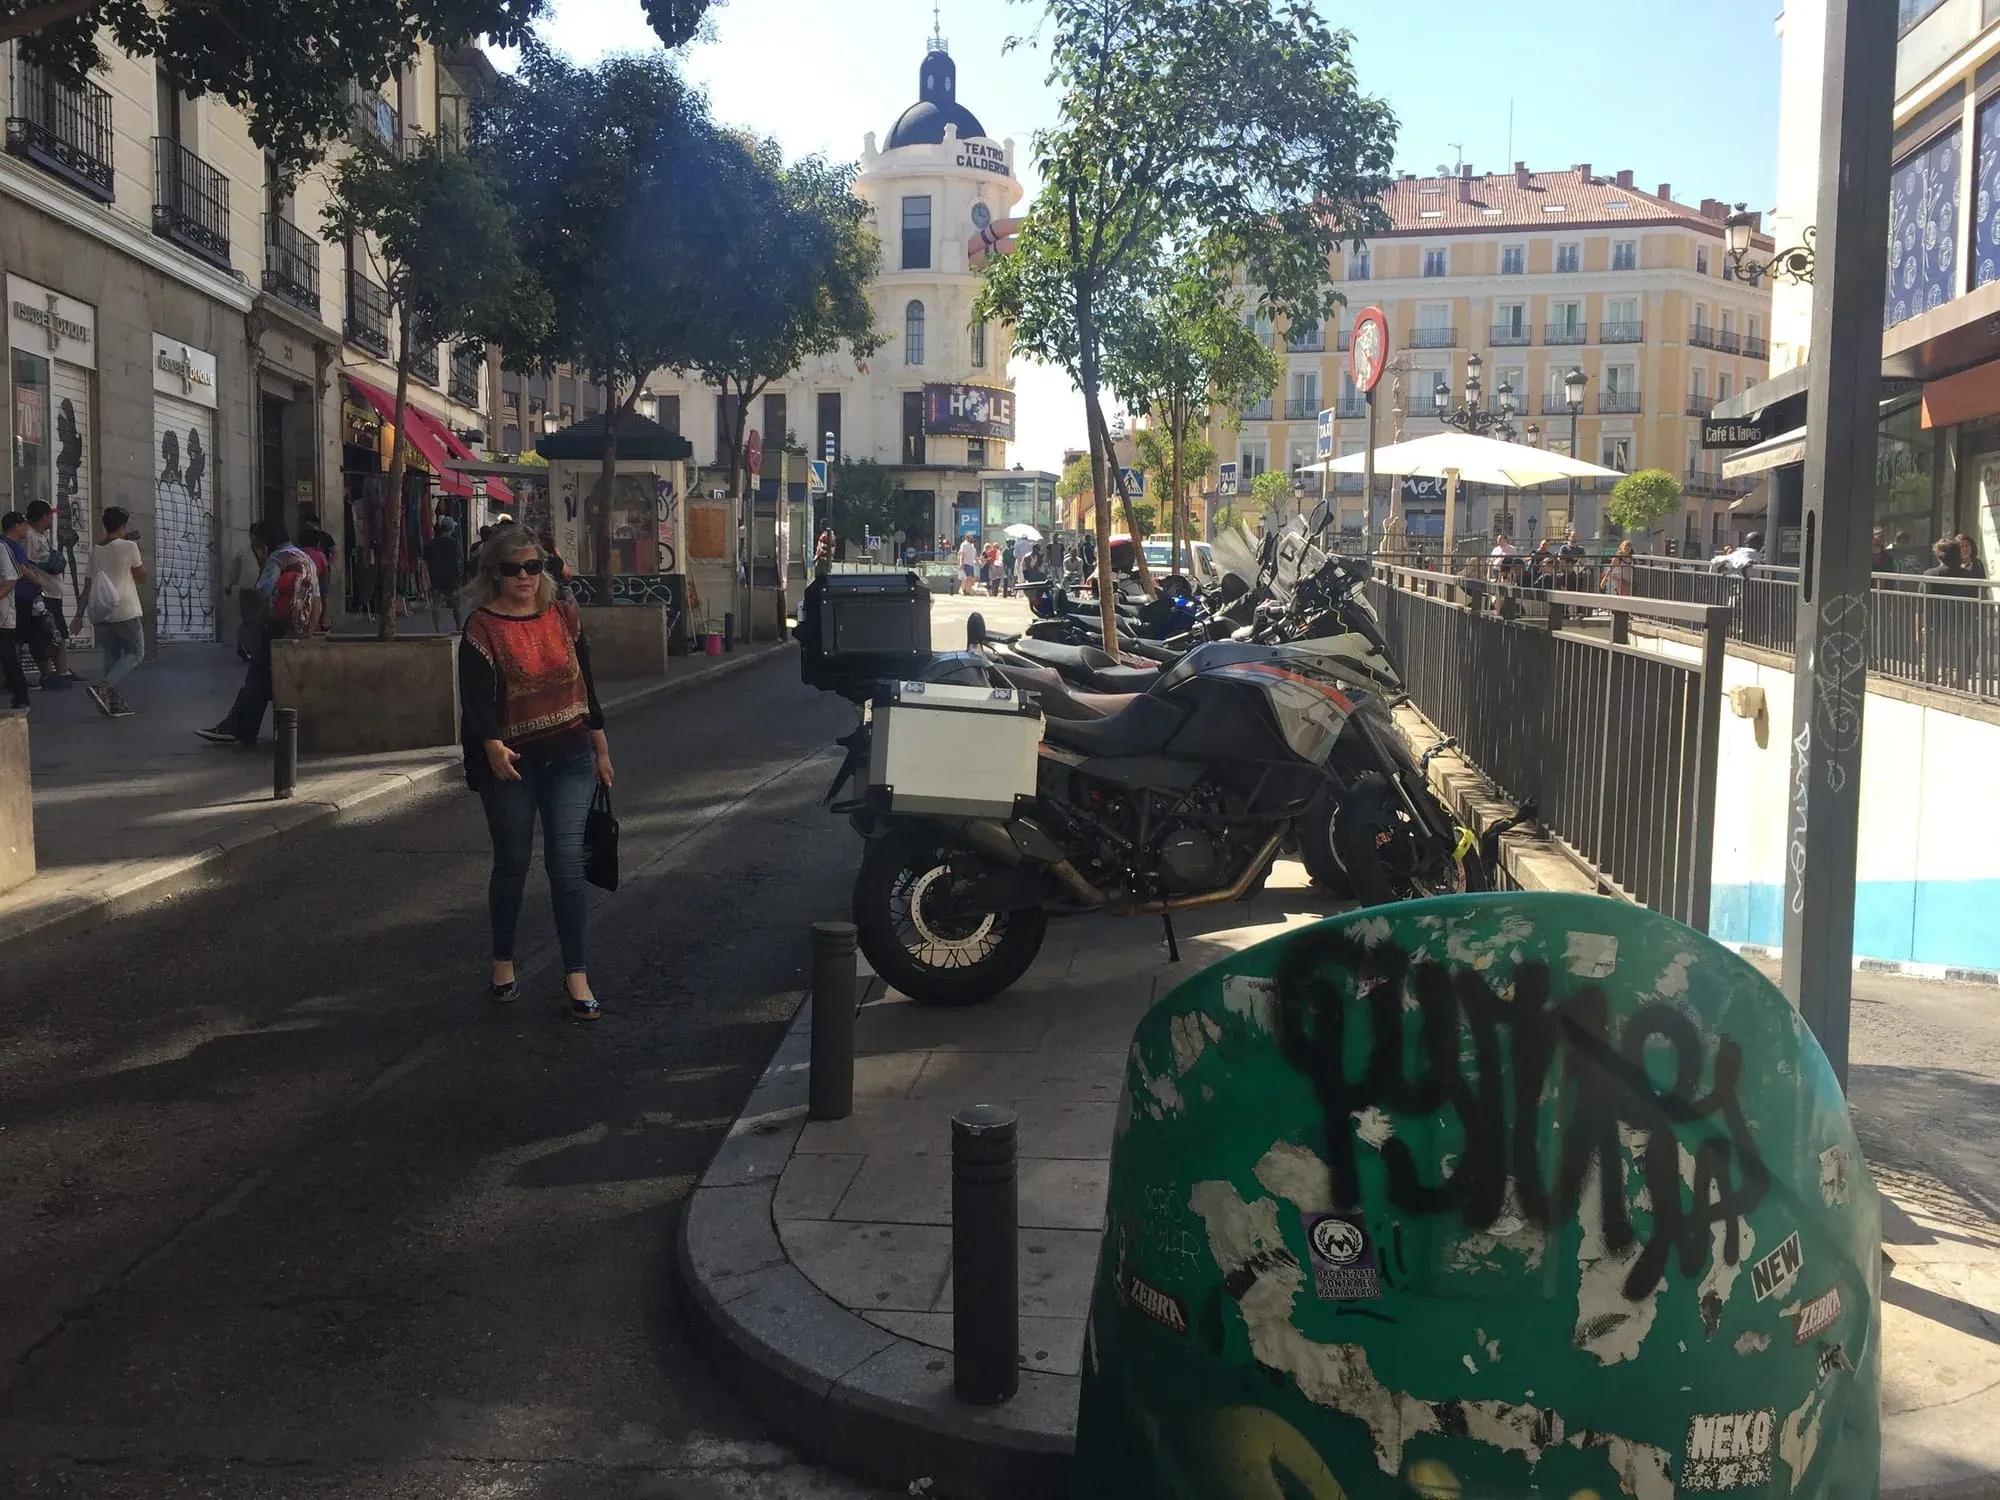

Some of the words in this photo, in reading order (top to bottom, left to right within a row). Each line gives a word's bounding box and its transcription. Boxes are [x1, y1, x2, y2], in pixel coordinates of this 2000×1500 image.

[963, 142, 1003, 161] TEATRO
[956, 155, 1009, 176] CALDERON
[57, 318, 91, 343] DUQUE
[951, 387, 964, 395] THE
[1706, 425, 1727, 442] Café
[1729, 426, 1736, 441] &
[1737, 425, 1761, 441] Tapas
[1221, 472, 1236, 483] TAXI
[1752, 1234, 1800, 1299] NEW
[1318, 1288, 1379, 1297] PATRIARCADO
[1321, 1279, 1361, 1288] CONTRA
[1130, 1276, 1186, 1327] ZEBRA
[1797, 1287, 1841, 1336] ZEBRA
[1691, 1411, 1770, 1459] NEKO
